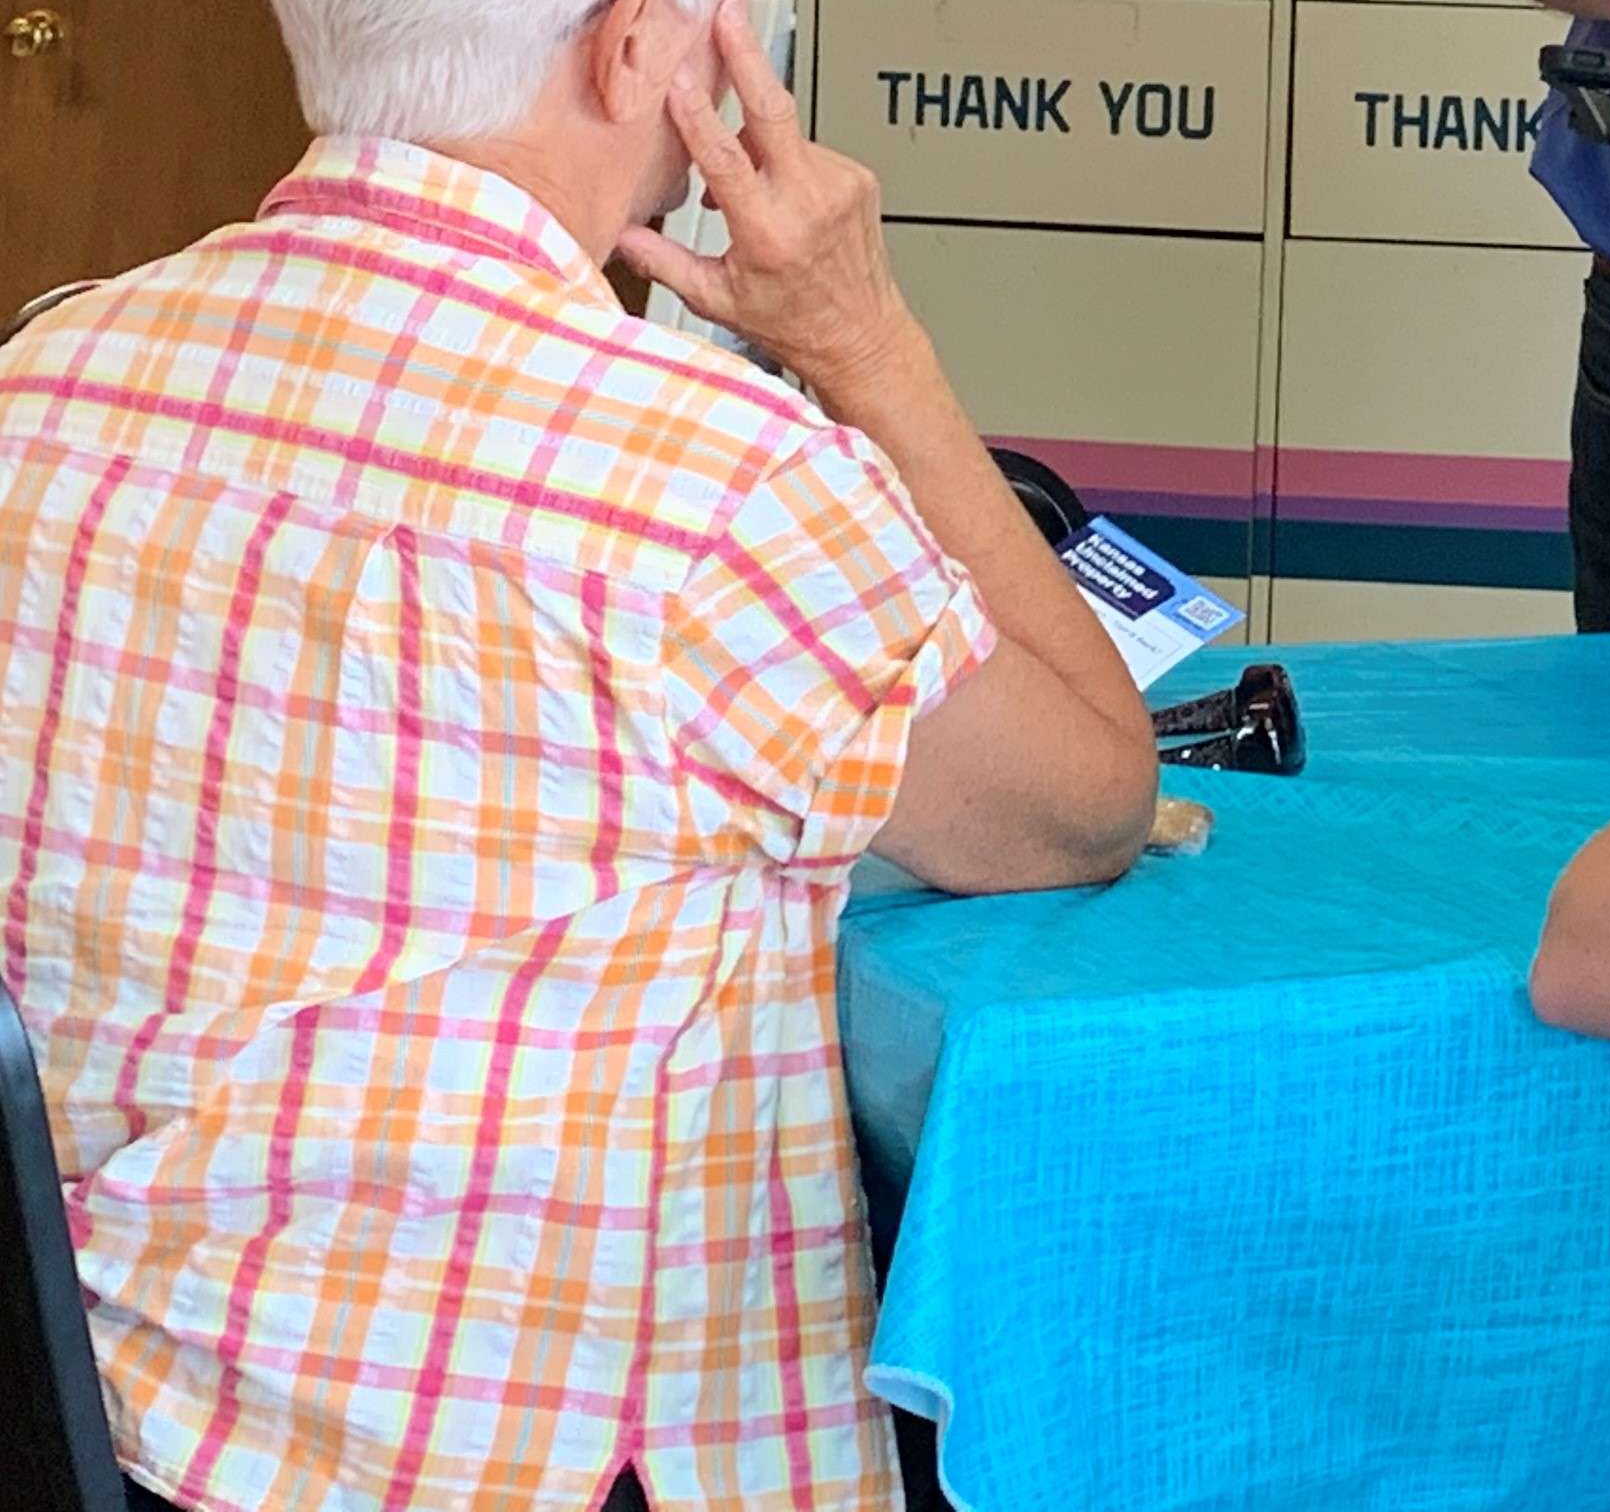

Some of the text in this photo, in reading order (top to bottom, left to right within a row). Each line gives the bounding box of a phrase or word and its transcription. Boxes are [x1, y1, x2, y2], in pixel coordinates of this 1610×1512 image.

[877, 71, 1217, 140] THANK YOU
[1354, 92, 1544, 154] THANK
[1061, 549, 1133, 599] Property
[1075, 541, 1159, 600] Unclaimed
[1088, 533, 1146, 576] Kansas
